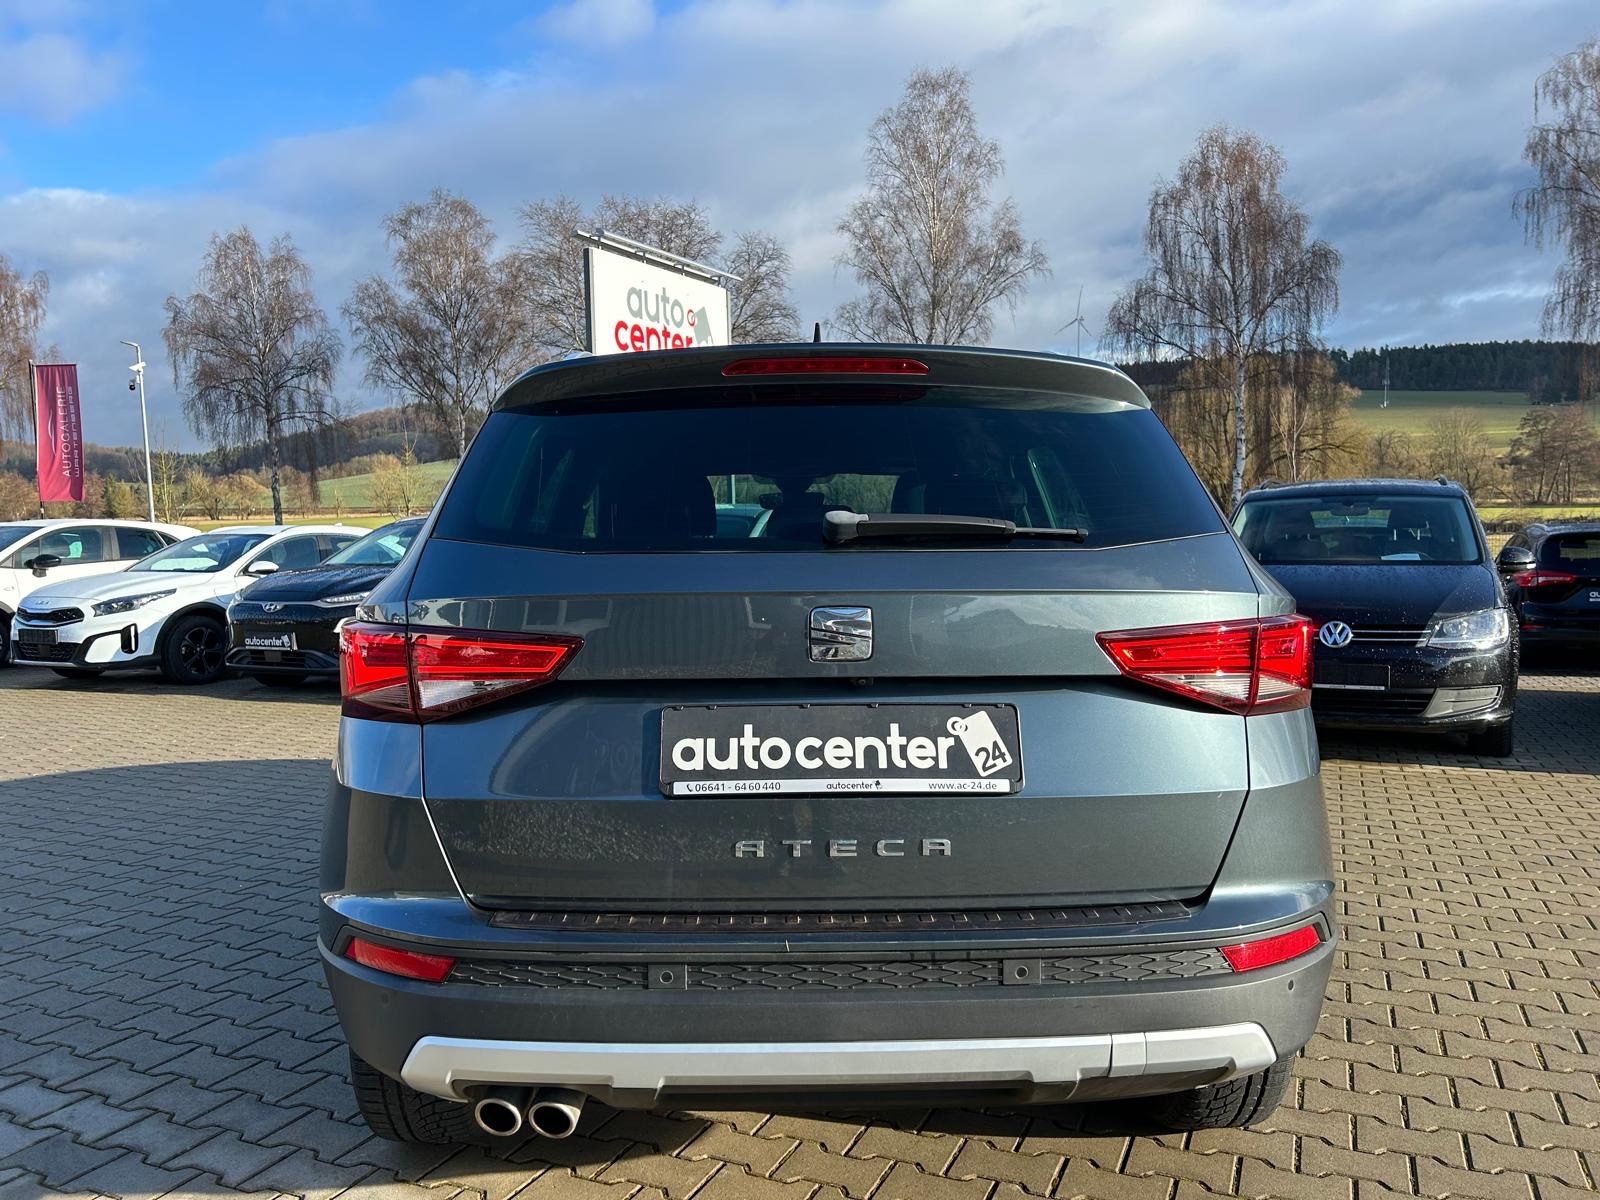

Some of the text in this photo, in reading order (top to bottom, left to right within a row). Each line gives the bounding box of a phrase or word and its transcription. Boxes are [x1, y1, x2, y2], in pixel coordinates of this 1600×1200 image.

[627, 286, 685, 329] auto
[56, 386, 72, 477] AUTOGALERIE
[245, 637, 282, 646] autocenter
[672, 723, 1008, 773] autocenter 24
[695, 783, 725, 792] 06641
[826, 780, 873, 790] autocenter
[928, 781, 997, 790] www.ac-24.de
[735, 838, 952, 858] ATECA
